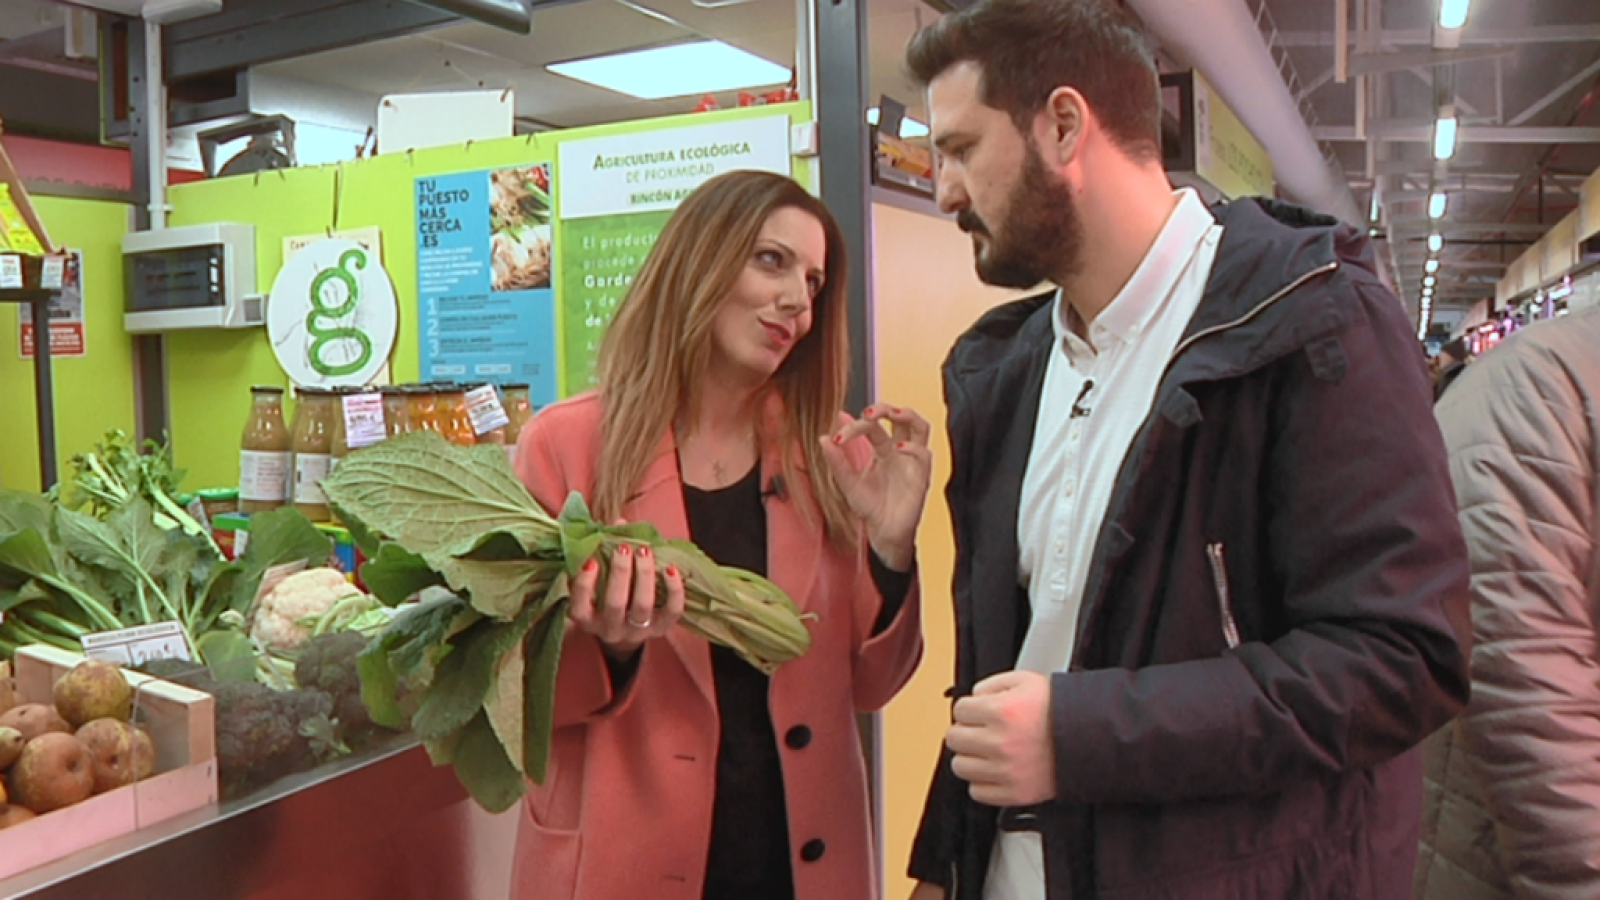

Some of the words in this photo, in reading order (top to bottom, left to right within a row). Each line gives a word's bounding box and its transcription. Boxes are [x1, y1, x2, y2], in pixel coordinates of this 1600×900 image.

[593, 150, 675, 170] AGRICULTURA
[680, 142, 751, 161] ECOLÓGICA
[419, 179, 436, 193] TU
[419, 189, 470, 206] PUESTO
[419, 219, 462, 234] CERCA
[583, 235, 595, 249] El
[583, 253, 636, 271] procede
[427, 318, 439, 336] 2
[585, 313, 602, 328] de
